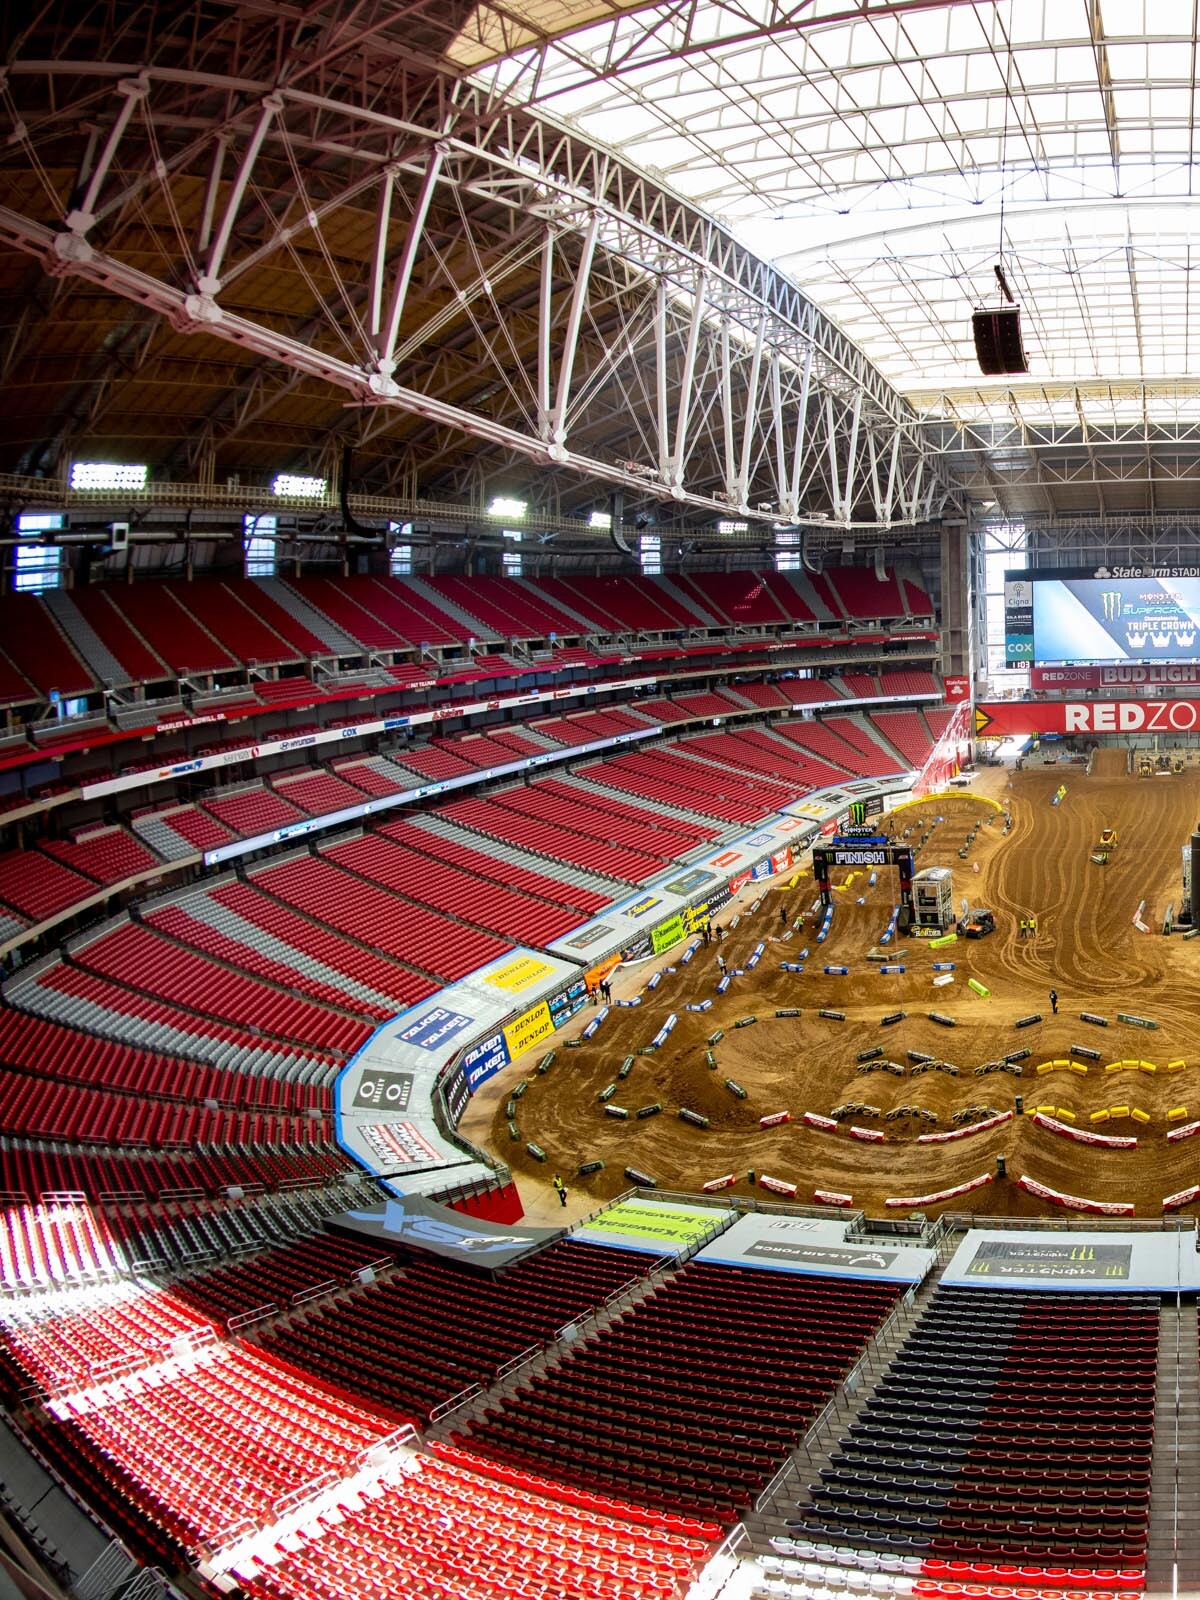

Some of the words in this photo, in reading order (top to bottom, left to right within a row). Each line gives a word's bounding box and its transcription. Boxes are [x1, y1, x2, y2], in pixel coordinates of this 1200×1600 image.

[1128, 622, 1158, 631] TRIPLE
[1161, 622, 1194, 631] CROWN
[1007, 643, 1032, 653] COX
[1105, 667, 1147, 683] BUD
[342, 727, 357, 738] COX
[835, 851, 885, 864] FINISH
[499, 960, 530, 980] DUNLOP
[516, 965, 548, 986] DUNLOP
[400, 1008, 446, 1040] FALKEN
[514, 1007, 546, 1033] DUNLOP
[421, 1015, 465, 1047] FALKEN
[518, 1022, 550, 1049] DUNLOP
[465, 1034, 502, 1067] FALKEN
[470, 1051, 505, 1084] FALKEN
[398, 1080, 412, 1106] OAKLEY
[754, 1244, 801, 1254] FORCE
[1000, 1266, 1096, 1275] MONSTER
